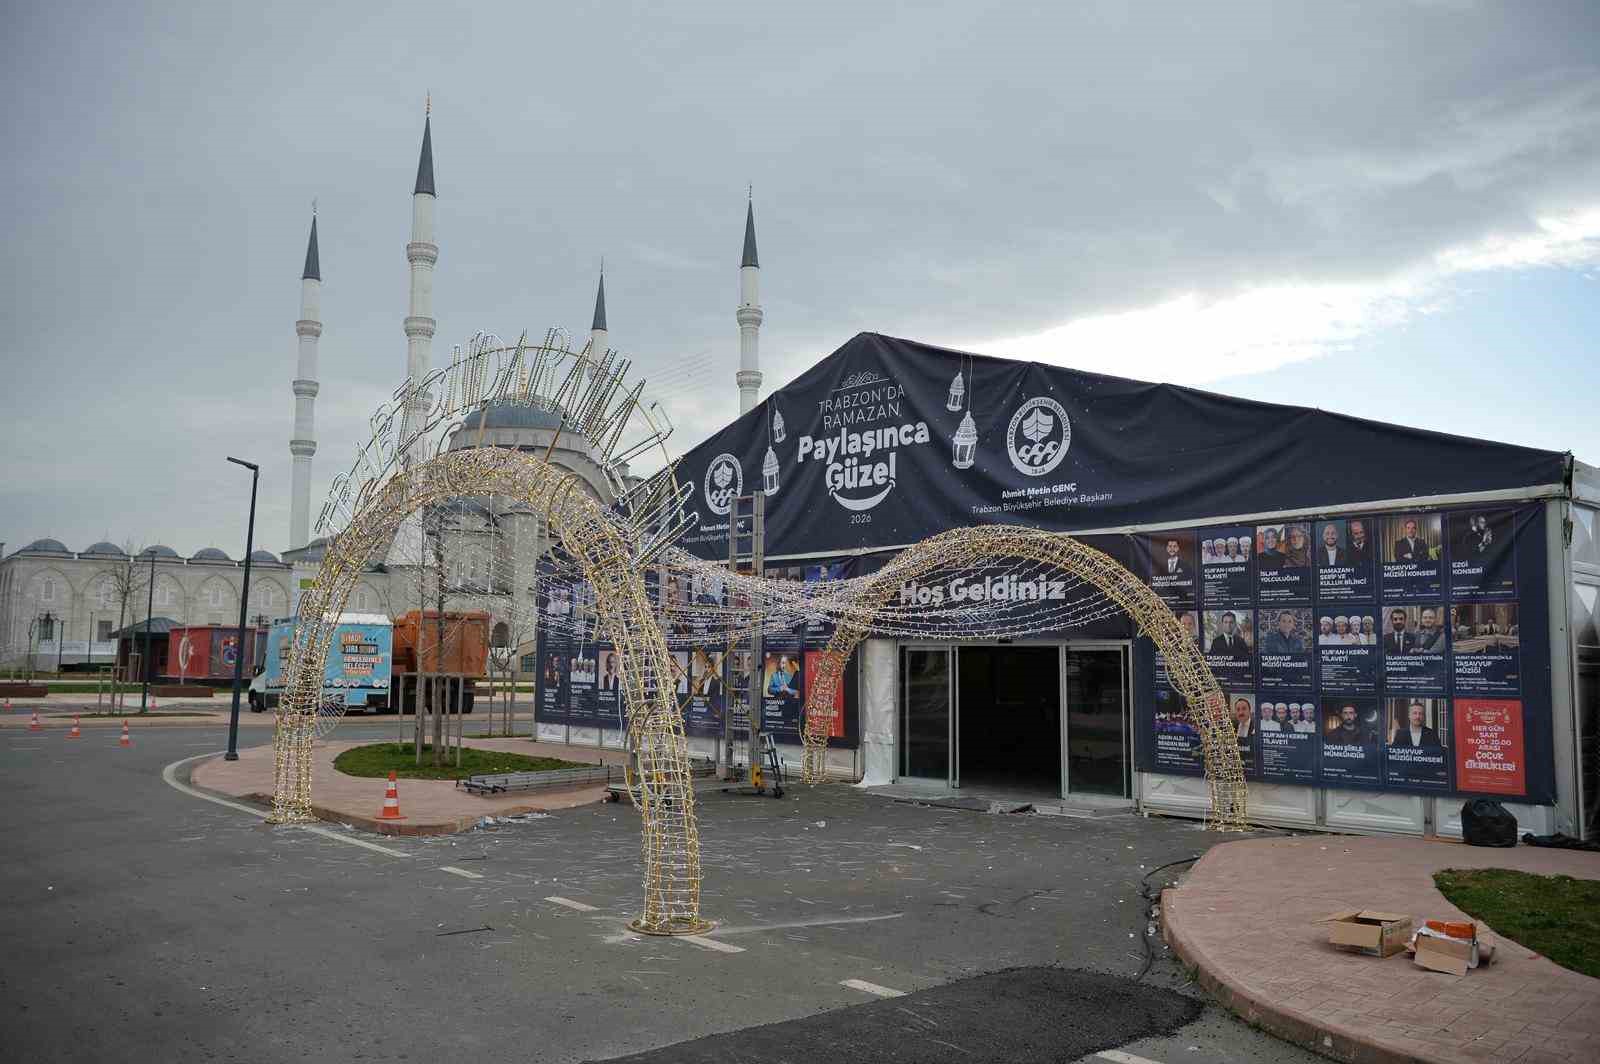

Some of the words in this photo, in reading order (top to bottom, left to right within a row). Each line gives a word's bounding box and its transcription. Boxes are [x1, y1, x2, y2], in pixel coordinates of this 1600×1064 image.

[819, 384, 905, 414] TRABZON'DA
[824, 402, 900, 430] RAMAZAN
[798, 421, 930, 465] Paylaşınca
[825, 452, 897, 491] Güzel
[971, 504, 1002, 515] Trabzon
[1003, 500, 1042, 513] Büyükşehir
[1043, 496, 1078, 508] Belediye
[1080, 492, 1113, 504] Başkanı
[1001, 489, 1026, 499] Ahmet
[1027, 486, 1051, 498] Metin
[1052, 482, 1077, 493] GENÇ
[849, 513, 872, 525] 2026
[899, 579, 945, 607] Hoş
[950, 573, 1067, 602] Geldiniz
